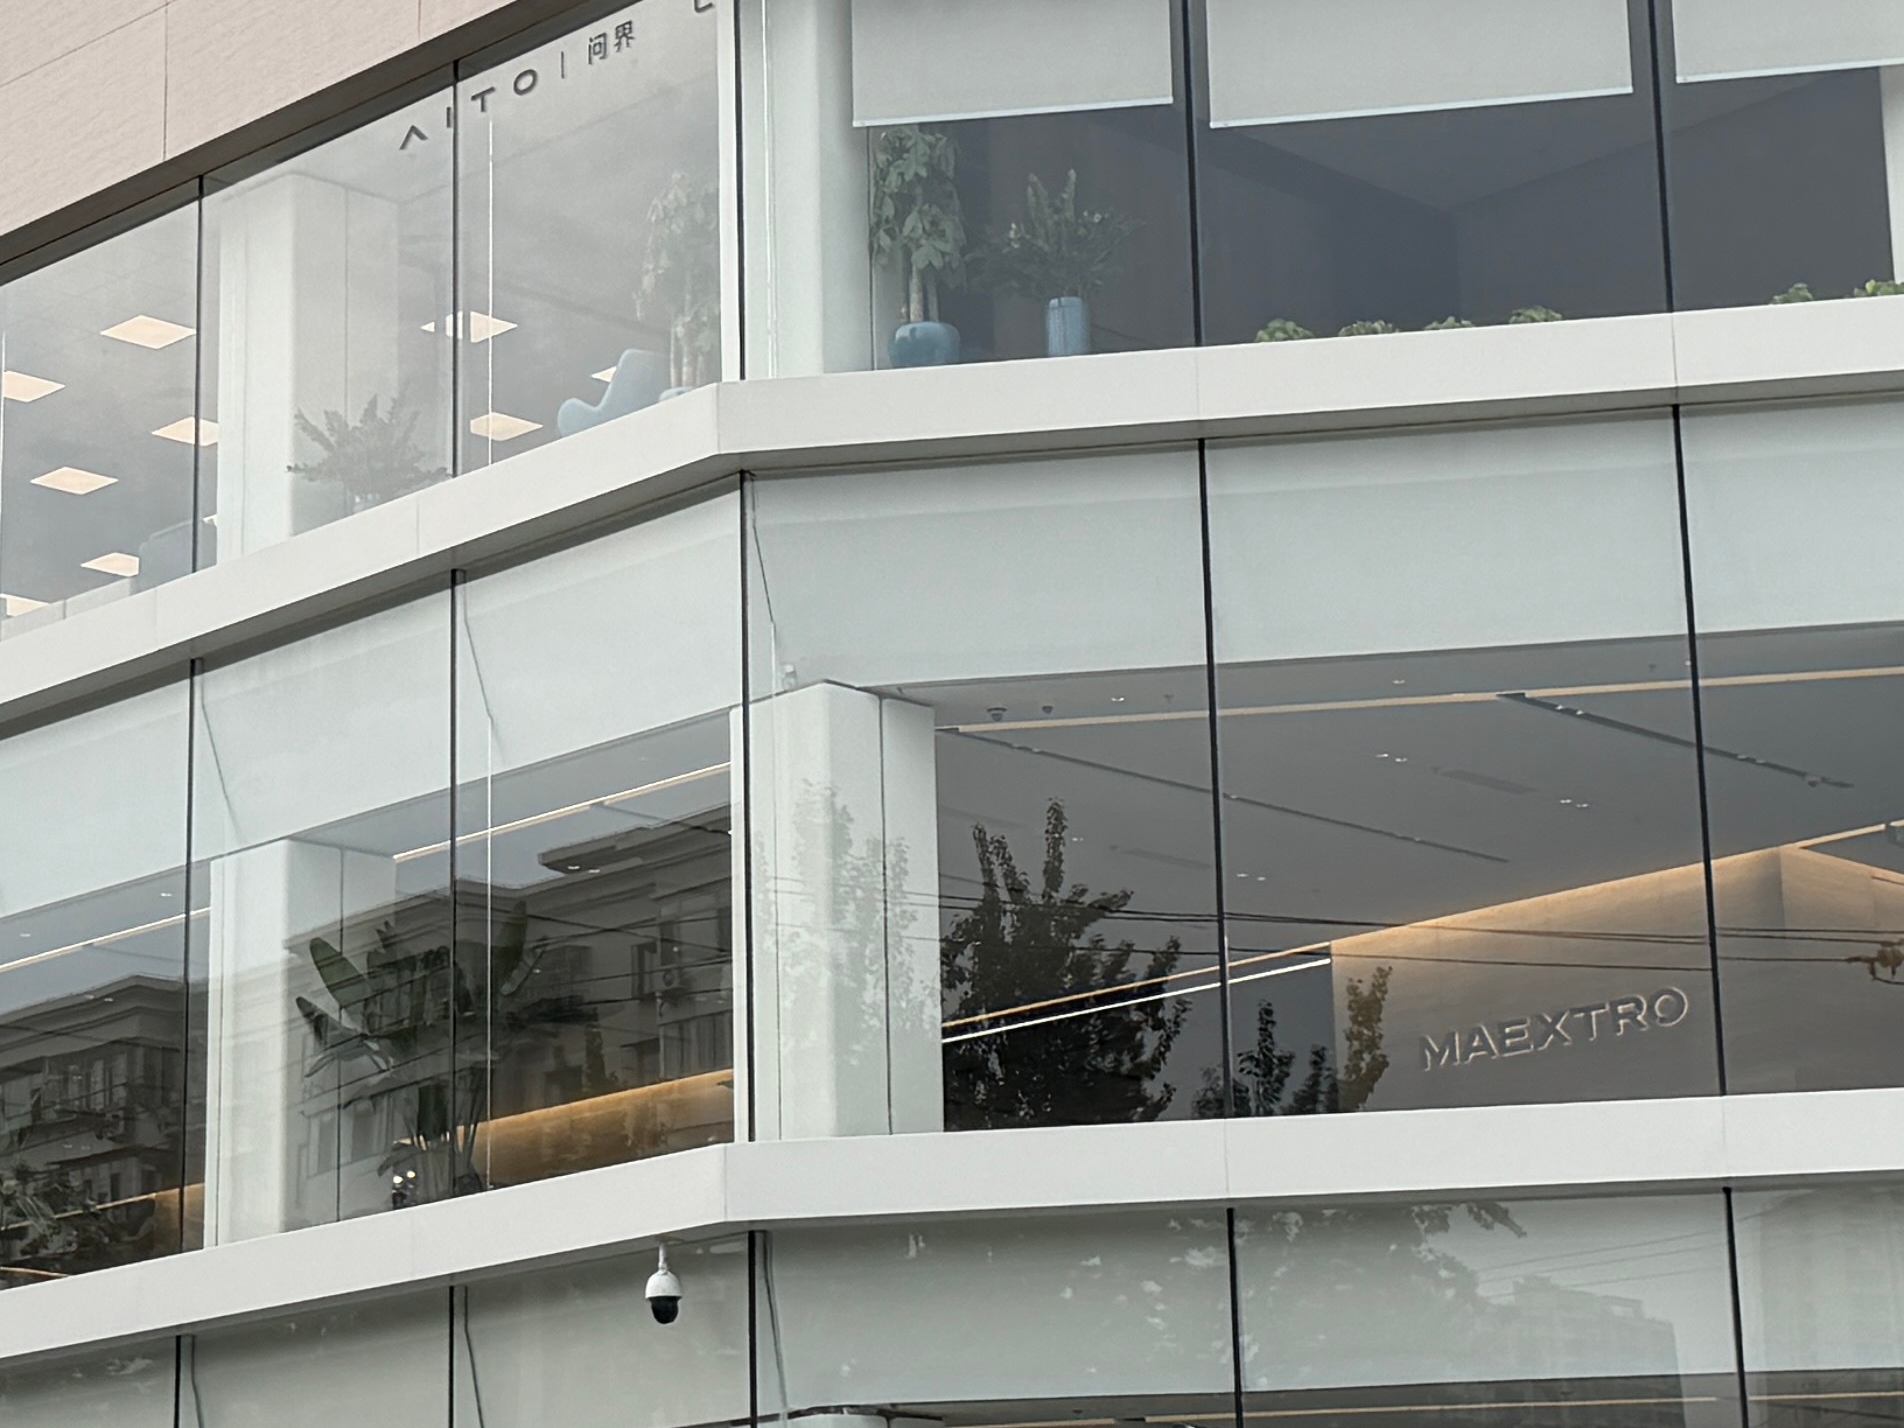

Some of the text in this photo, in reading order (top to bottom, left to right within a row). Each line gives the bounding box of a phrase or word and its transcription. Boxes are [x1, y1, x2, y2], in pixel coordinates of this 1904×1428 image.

[587, 19, 637, 67] 问界
[399, 67, 540, 152] AITO
[1419, 986, 1688, 1072] MAEXTRO
